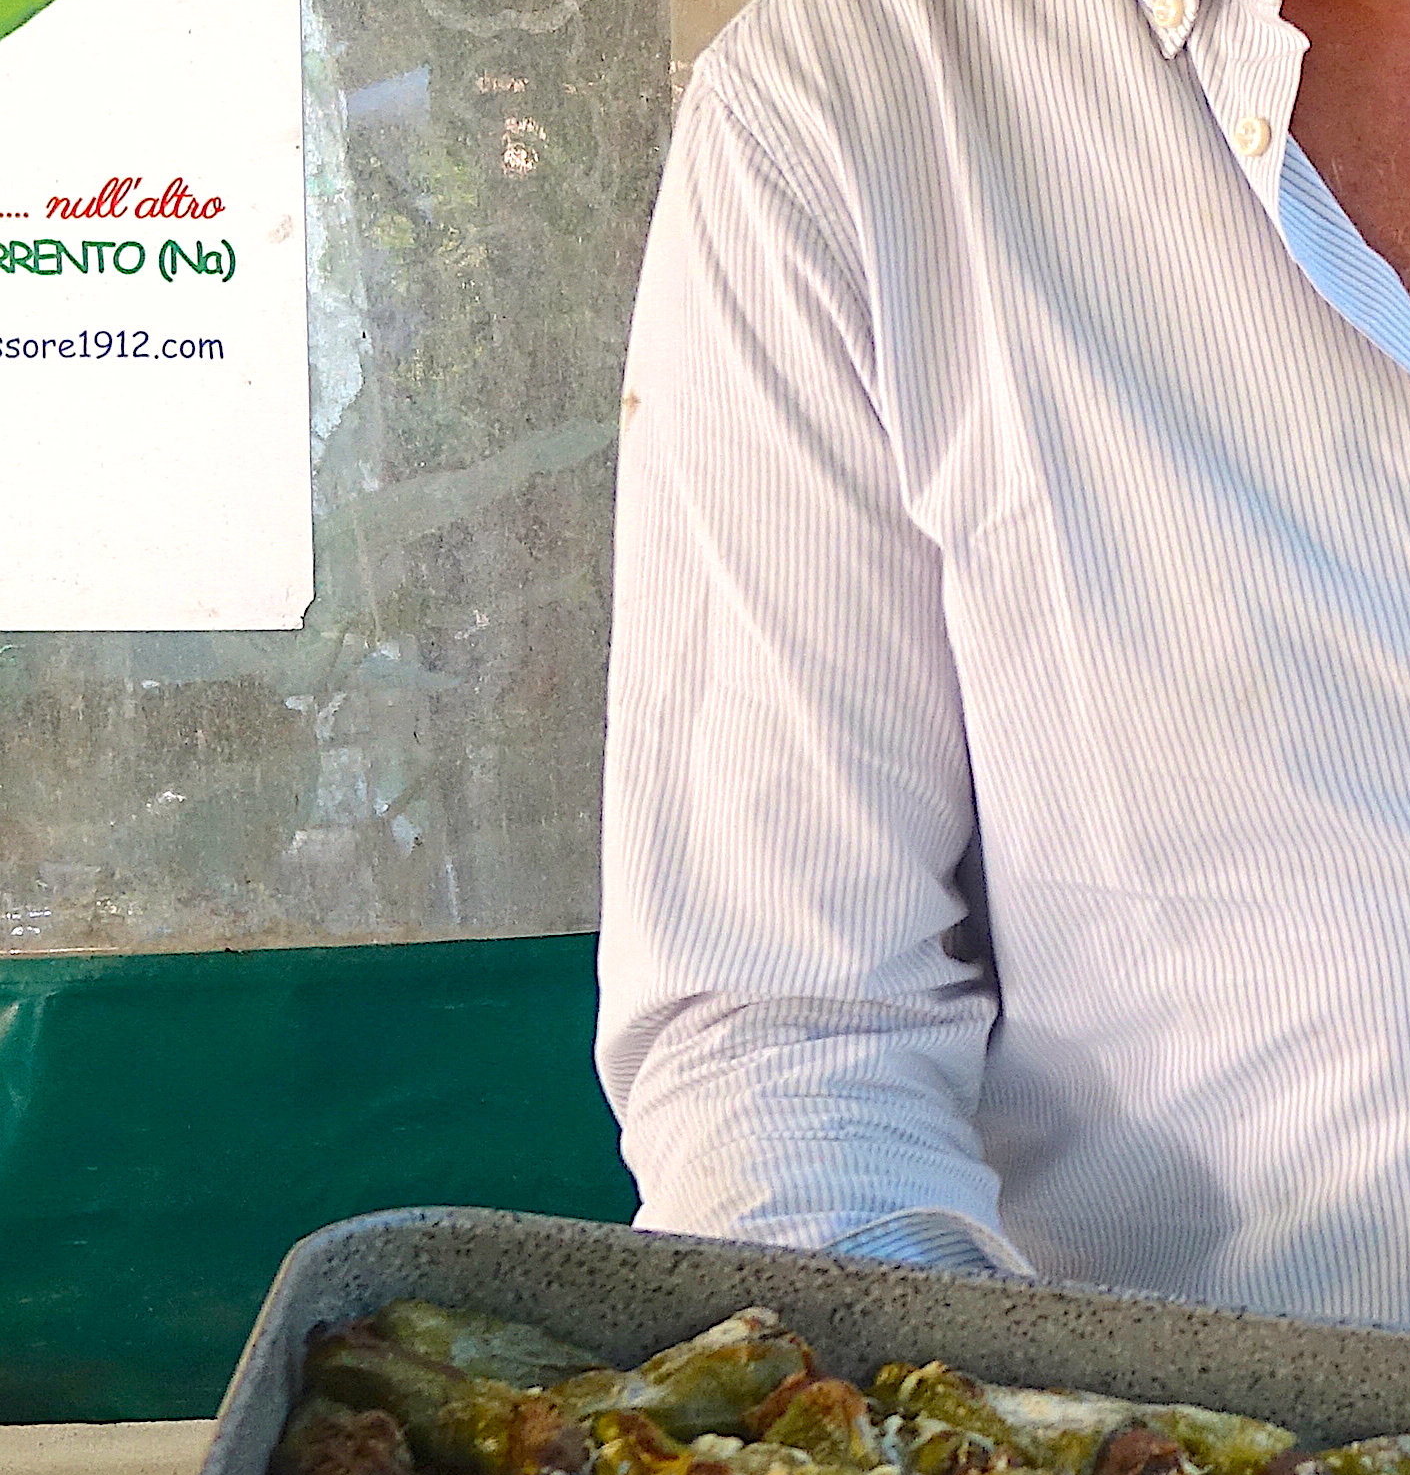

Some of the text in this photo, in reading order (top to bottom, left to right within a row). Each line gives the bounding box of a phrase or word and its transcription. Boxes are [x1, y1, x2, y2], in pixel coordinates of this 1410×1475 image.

[46, 176, 226, 220] null'altro
[158, 238, 236, 283] (Na)
[0, 330, 224, 360] sore1912.com
